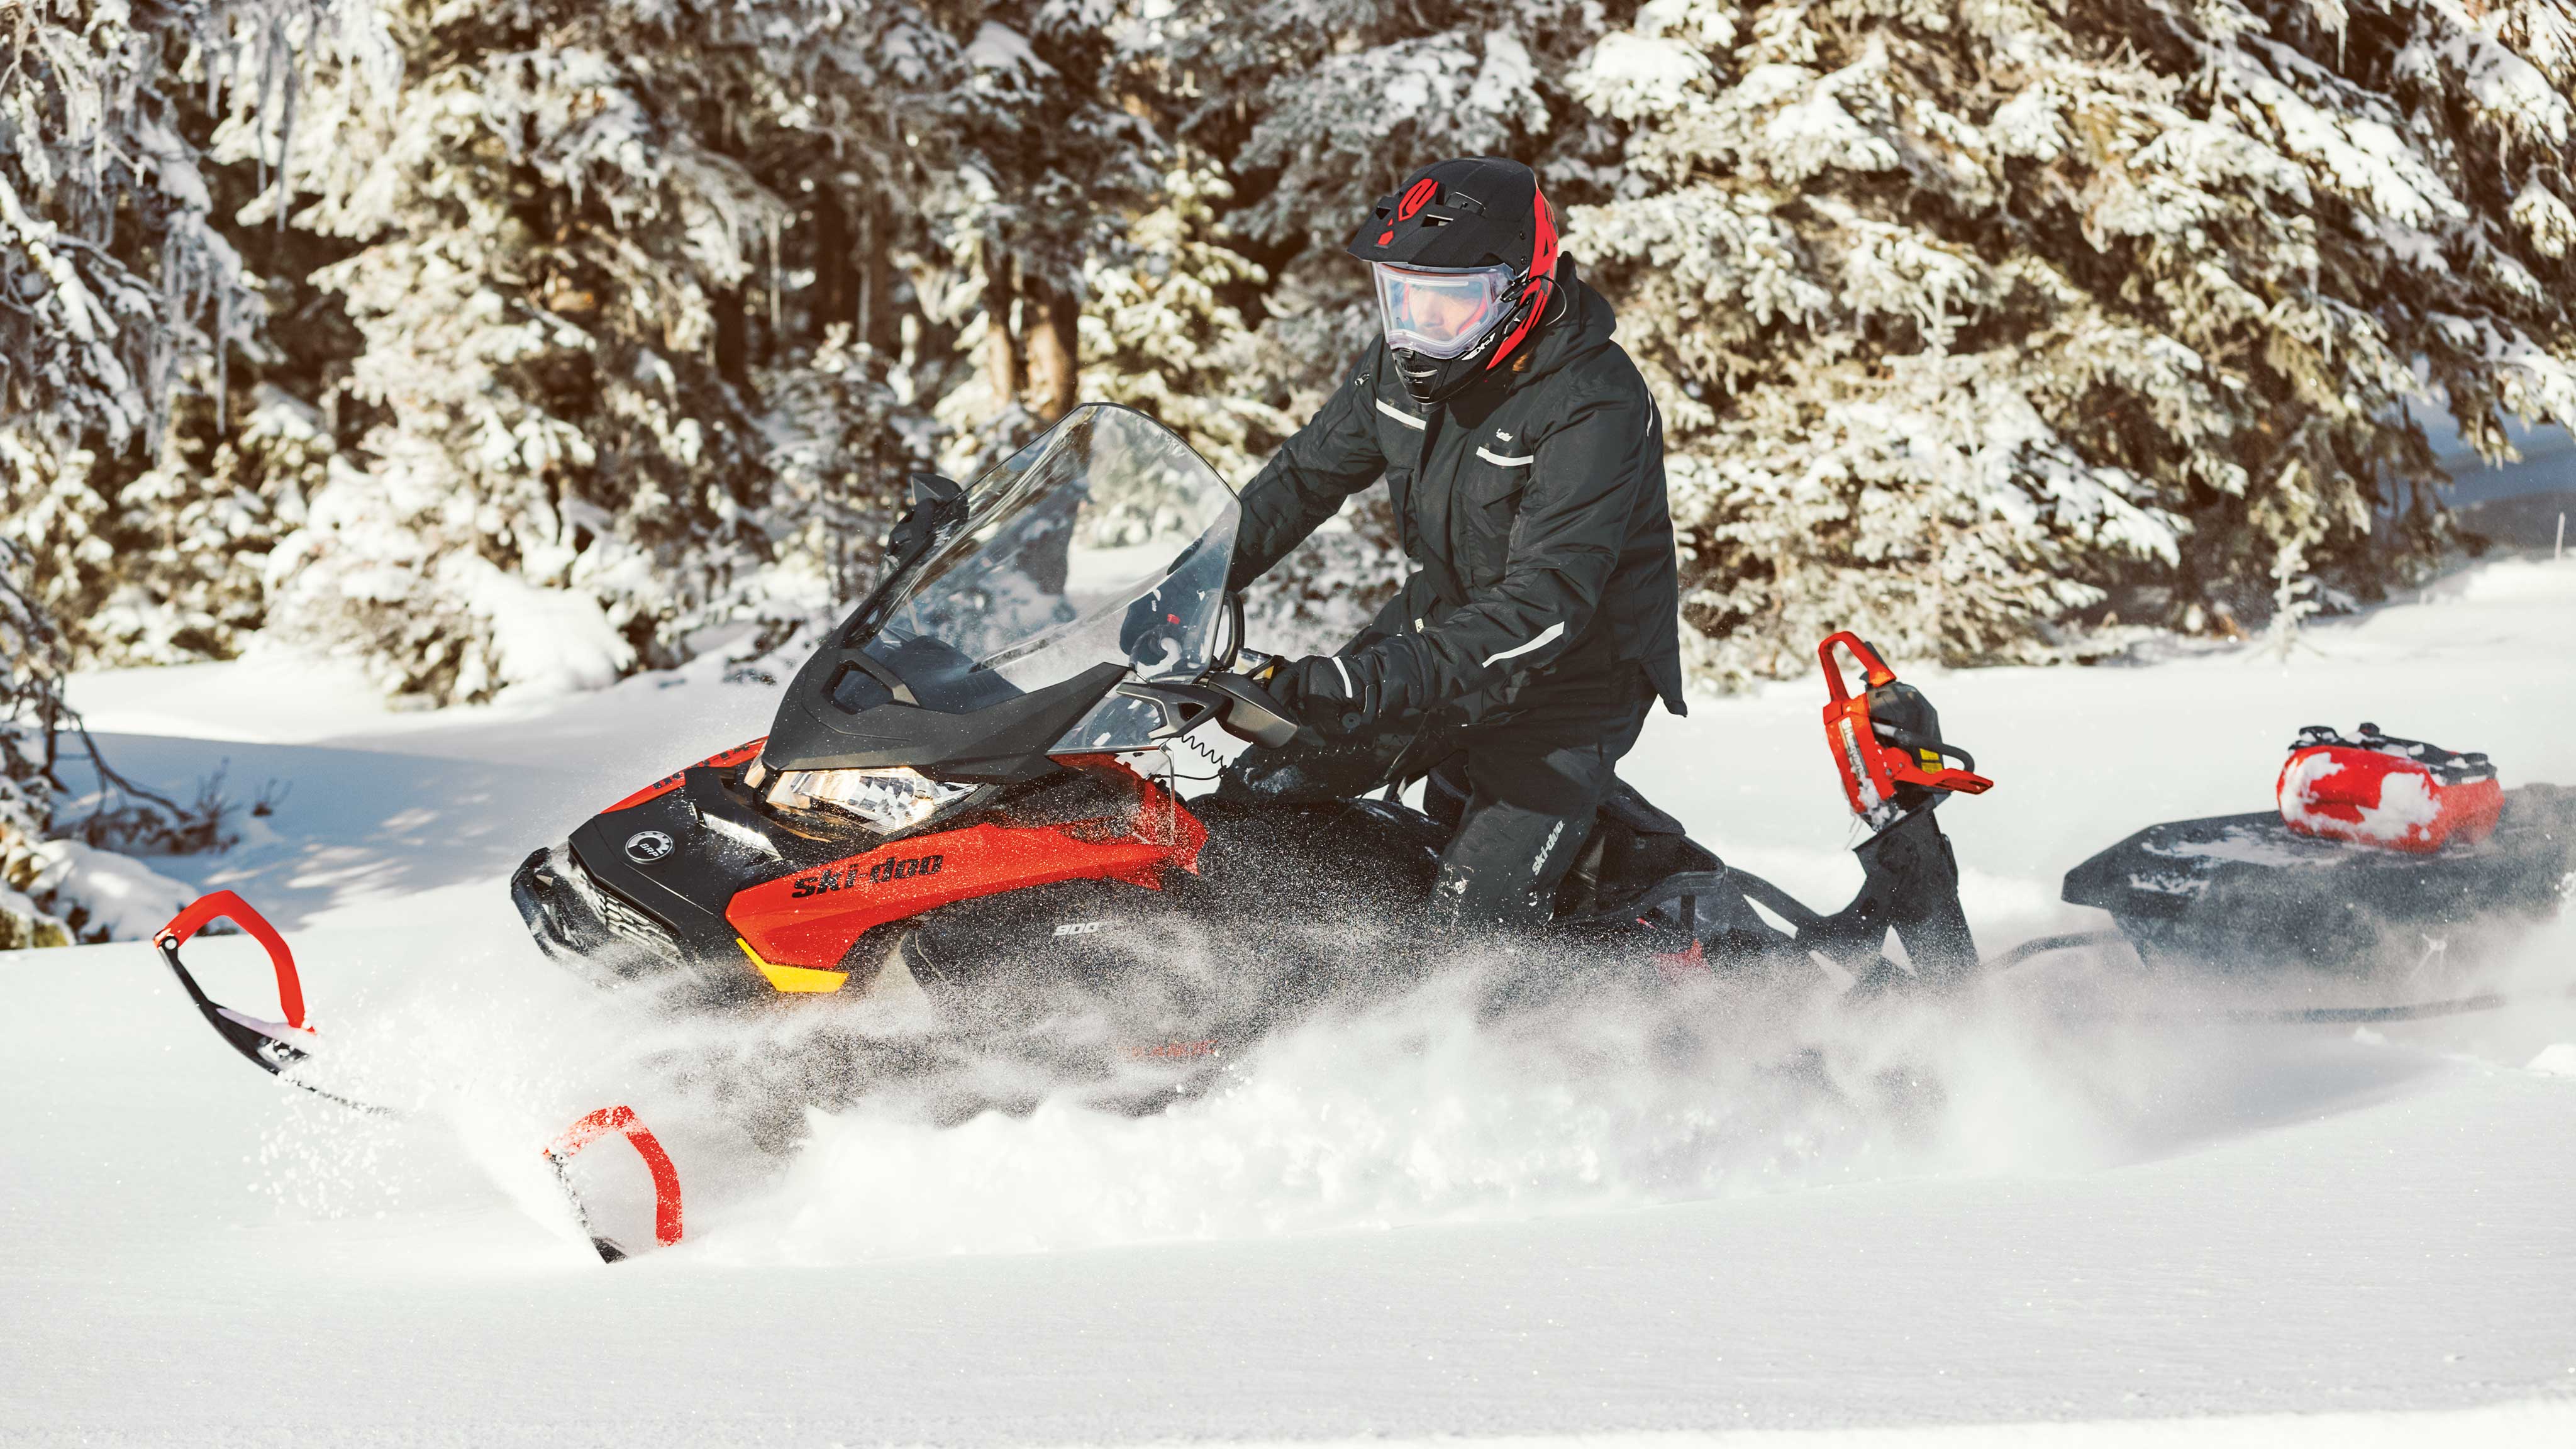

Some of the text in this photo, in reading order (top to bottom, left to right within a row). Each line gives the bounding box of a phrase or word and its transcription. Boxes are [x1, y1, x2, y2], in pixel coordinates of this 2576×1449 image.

[640, 843, 659, 857] BRP
[1532, 820, 1563, 876] ski-doo
[791, 855, 943, 898] ski-doo
[1052, 922, 1101, 936] 900
